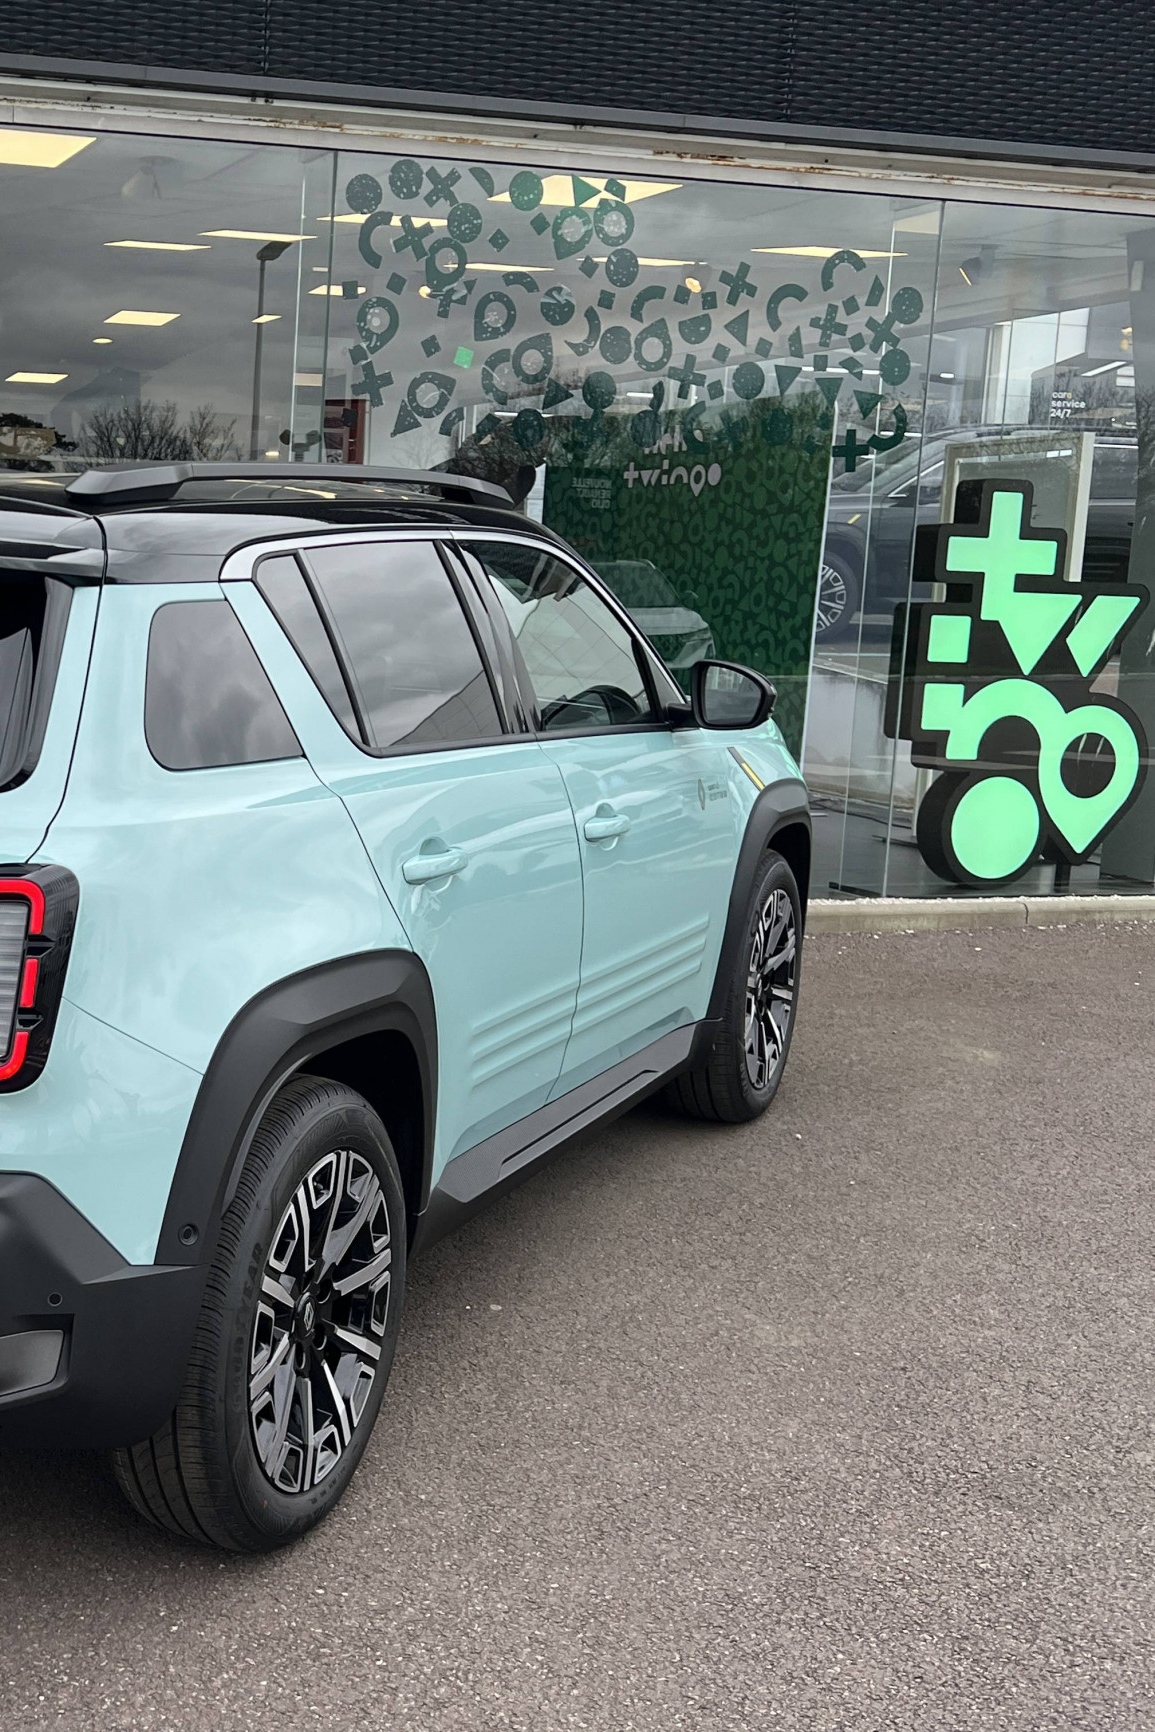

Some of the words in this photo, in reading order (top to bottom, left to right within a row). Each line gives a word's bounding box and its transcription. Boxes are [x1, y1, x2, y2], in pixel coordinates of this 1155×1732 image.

[1052, 391, 1072, 399] care
[1051, 400, 1086, 408] service
[1050, 409, 1071, 418] 24/7
[623, 459, 722, 497] twingo
